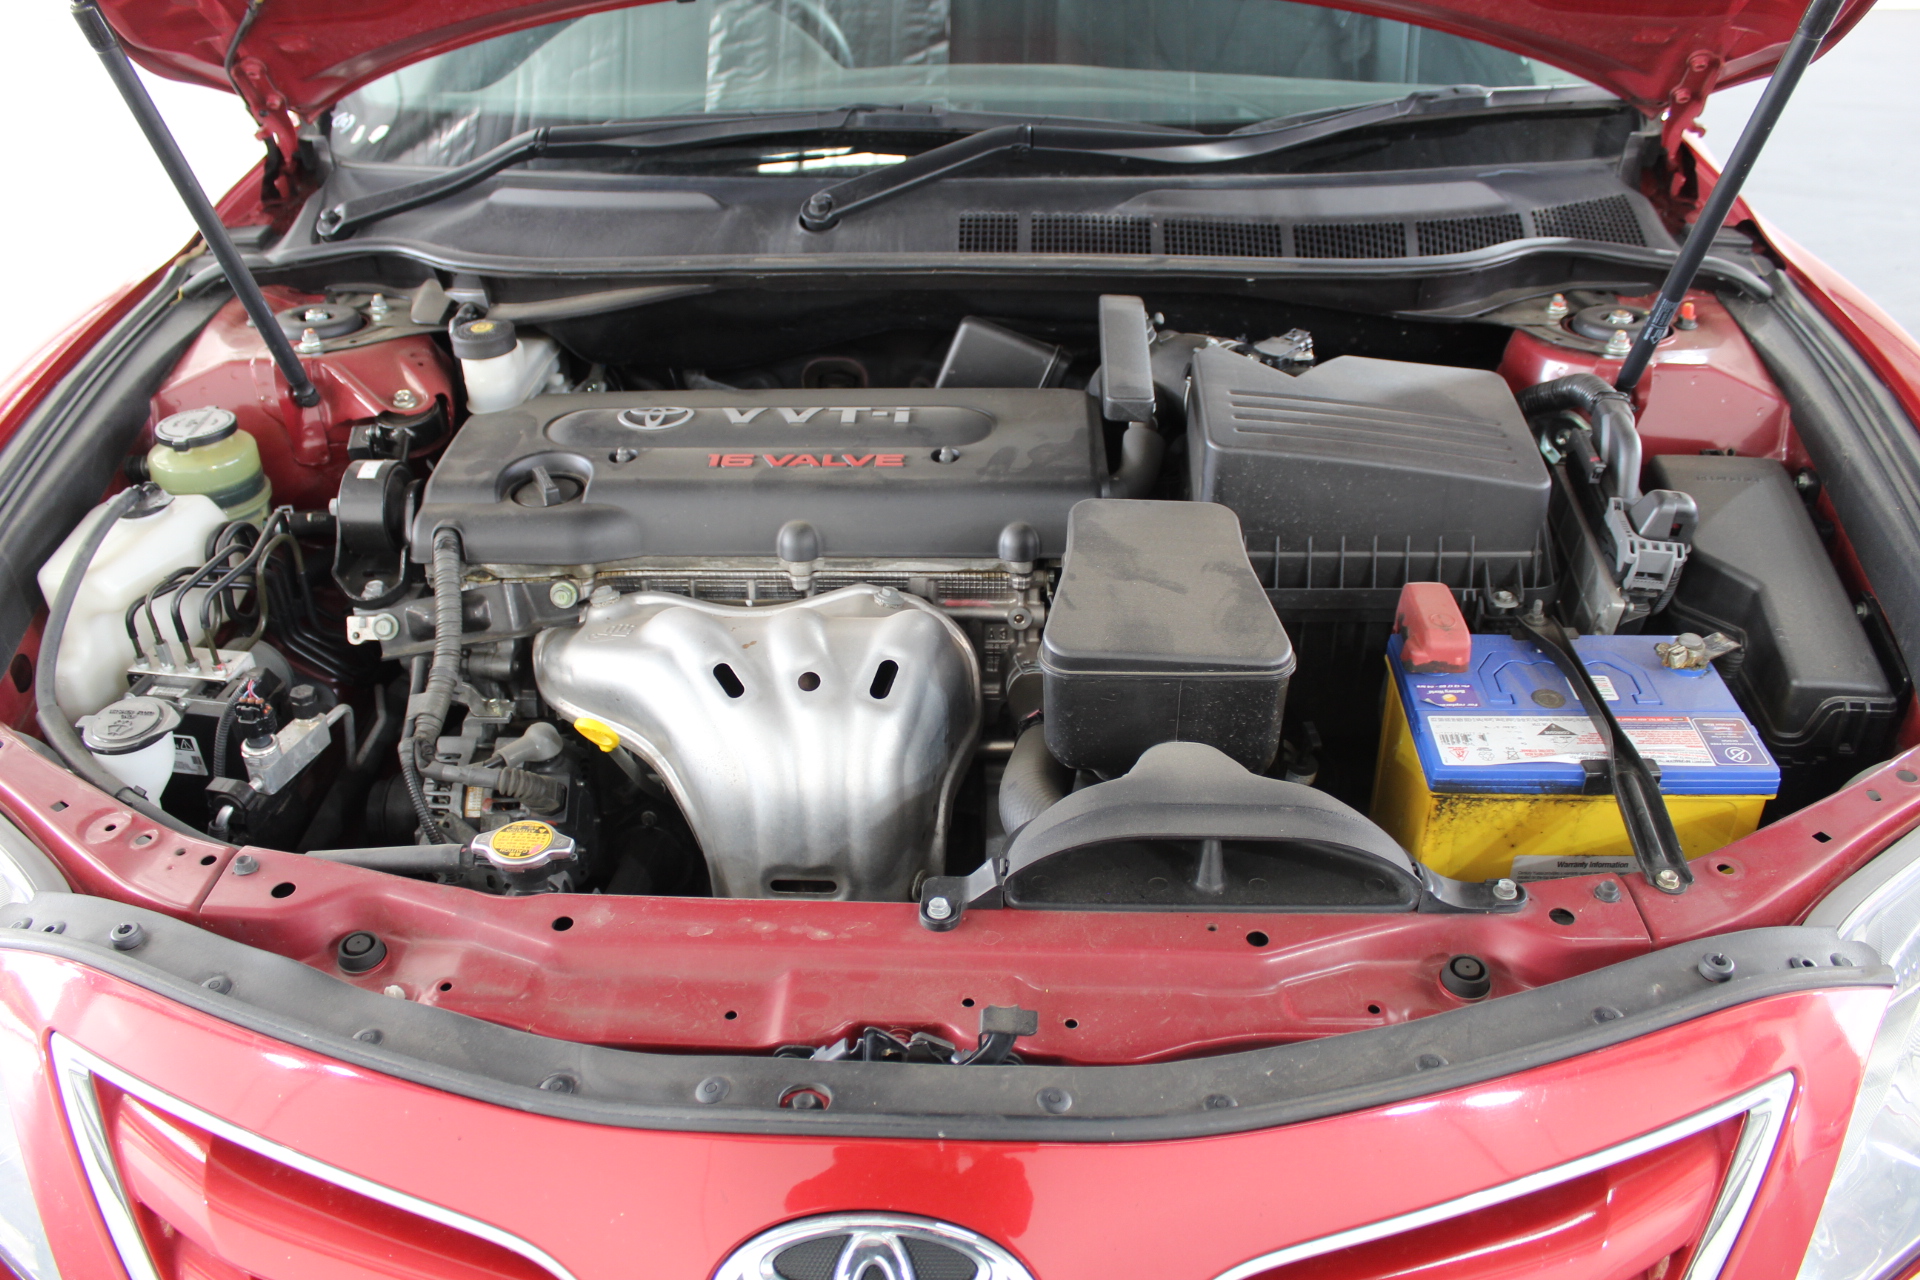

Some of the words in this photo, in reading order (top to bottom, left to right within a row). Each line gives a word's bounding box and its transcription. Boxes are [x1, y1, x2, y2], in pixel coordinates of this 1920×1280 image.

[707, 453, 756, 468] 16
[762, 453, 906, 468] VALVE
[1557, 861, 1587, 869] Warranty
